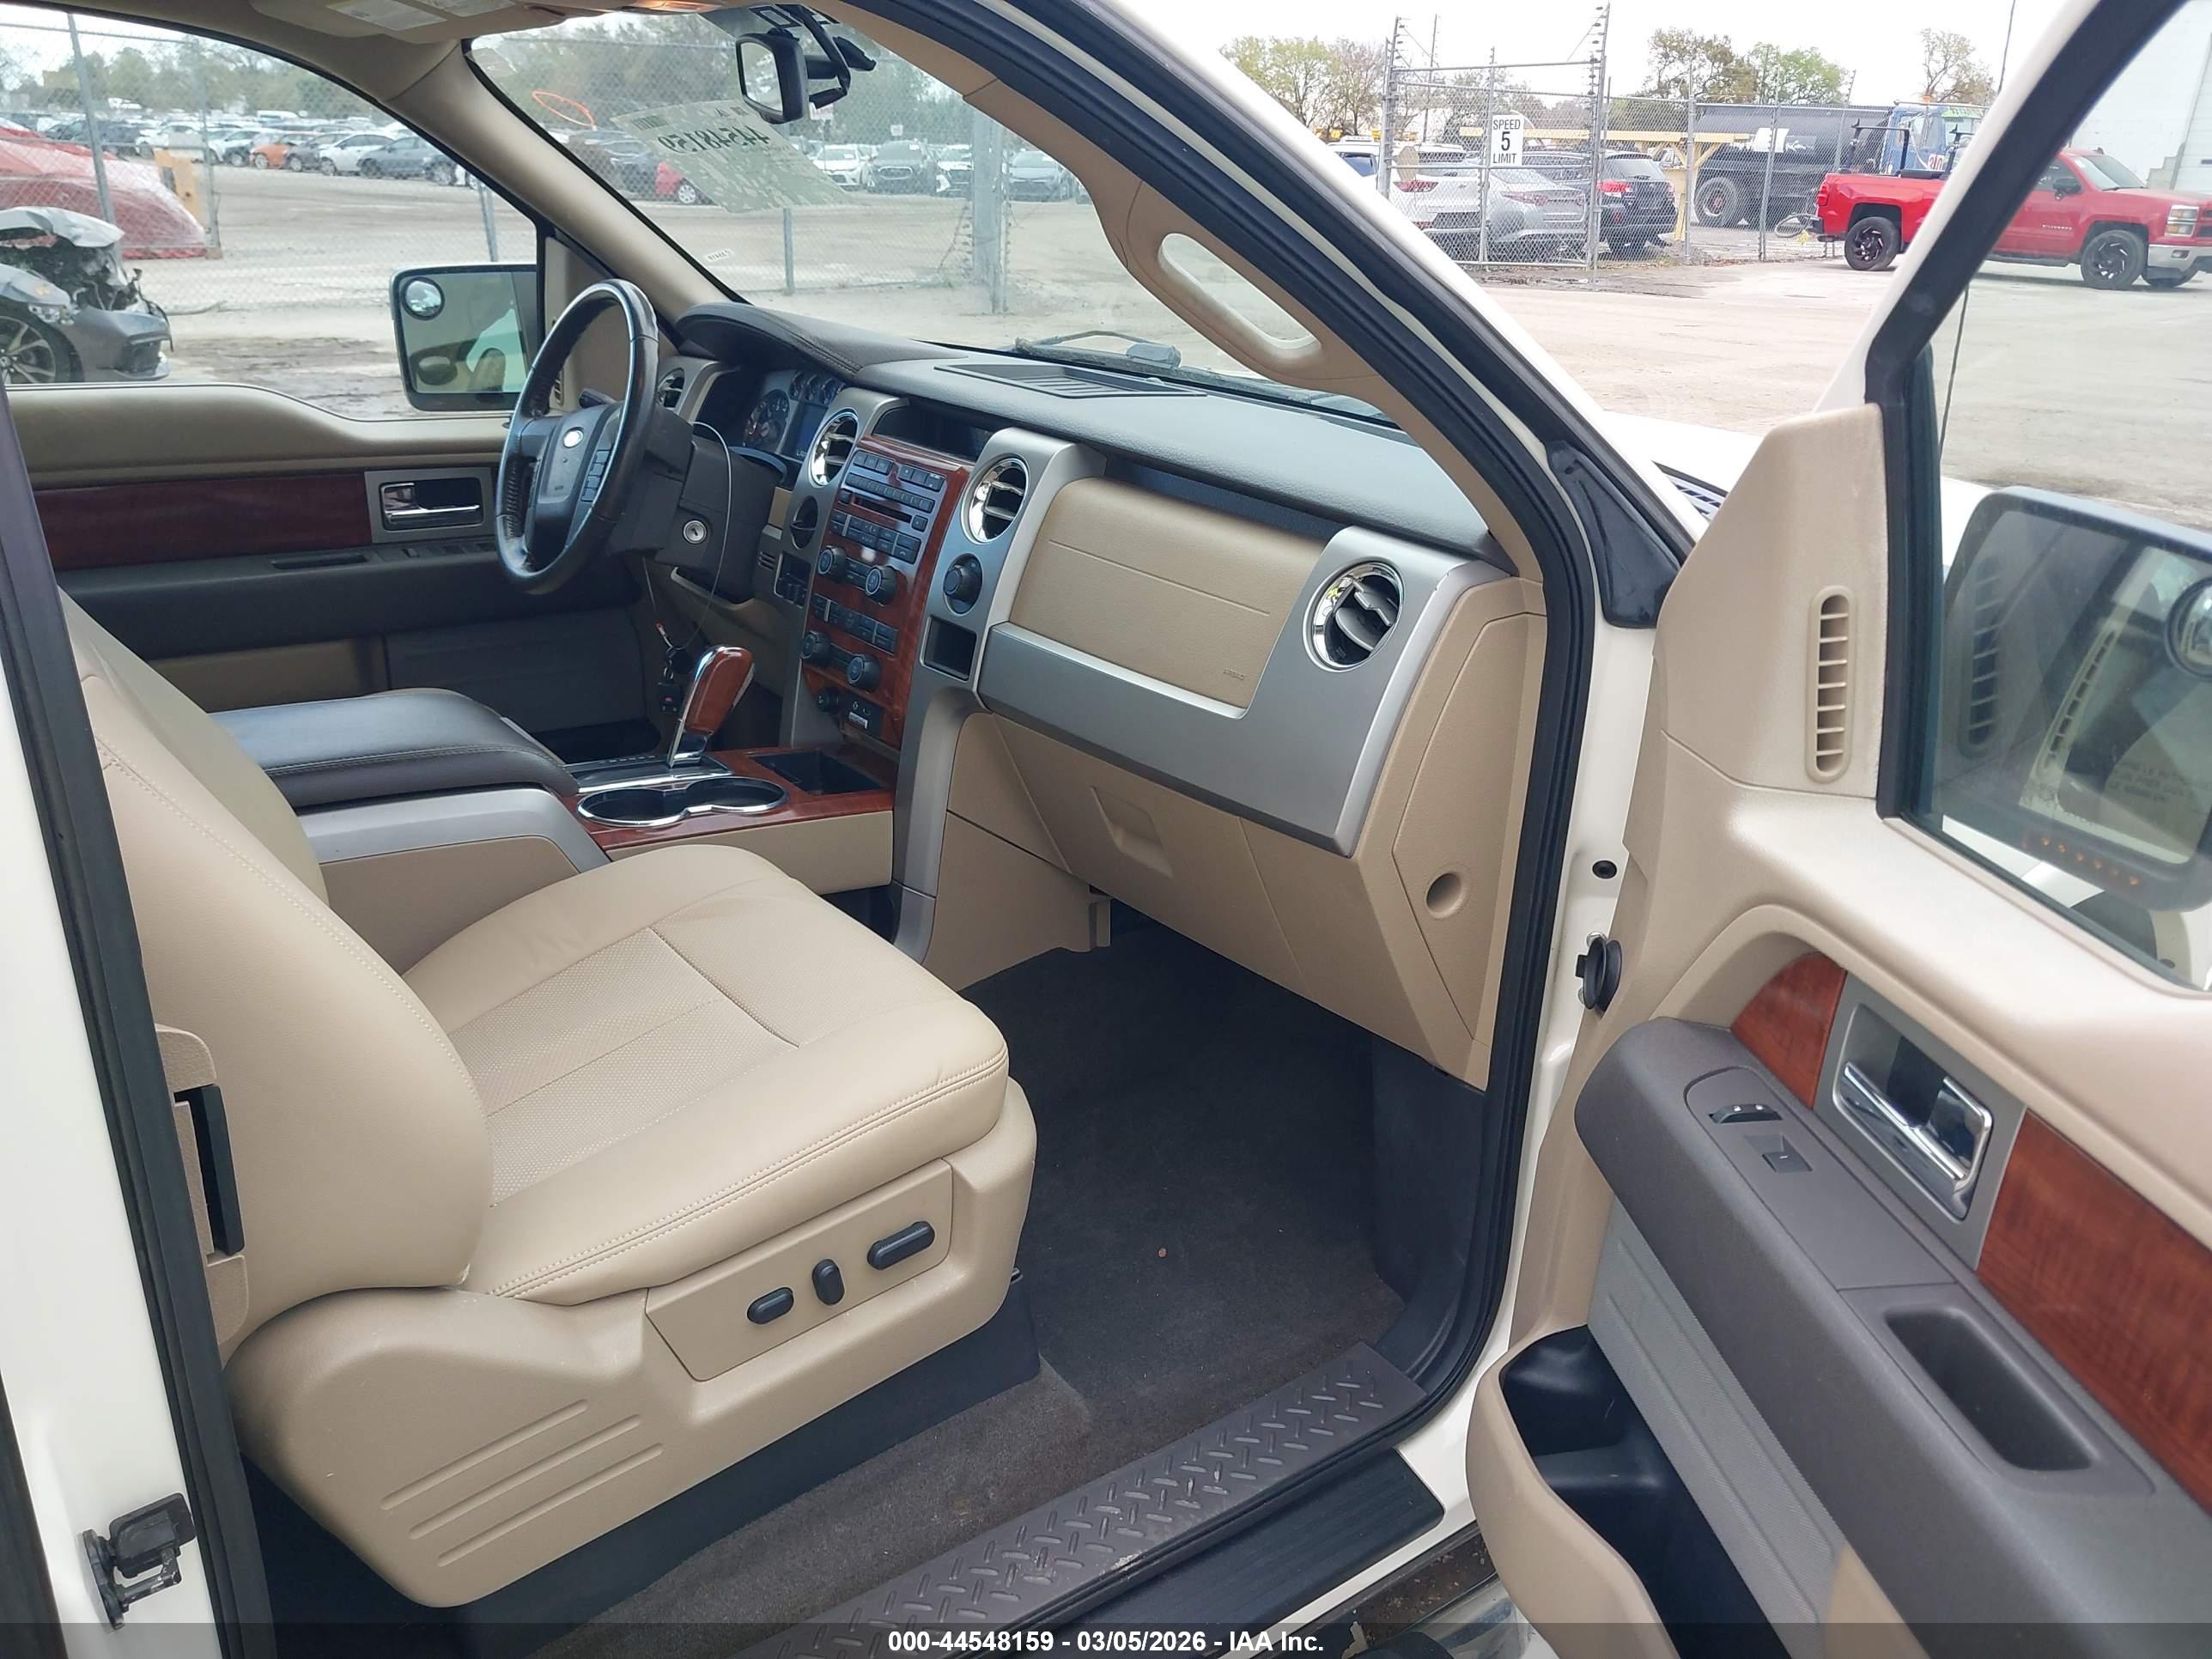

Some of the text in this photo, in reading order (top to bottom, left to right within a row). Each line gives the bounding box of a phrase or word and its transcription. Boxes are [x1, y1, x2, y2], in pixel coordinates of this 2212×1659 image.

[1492, 119, 1521, 131] SPEED
[1501, 131, 1510, 151] 5
[1492, 153, 1517, 164] LIMIT
